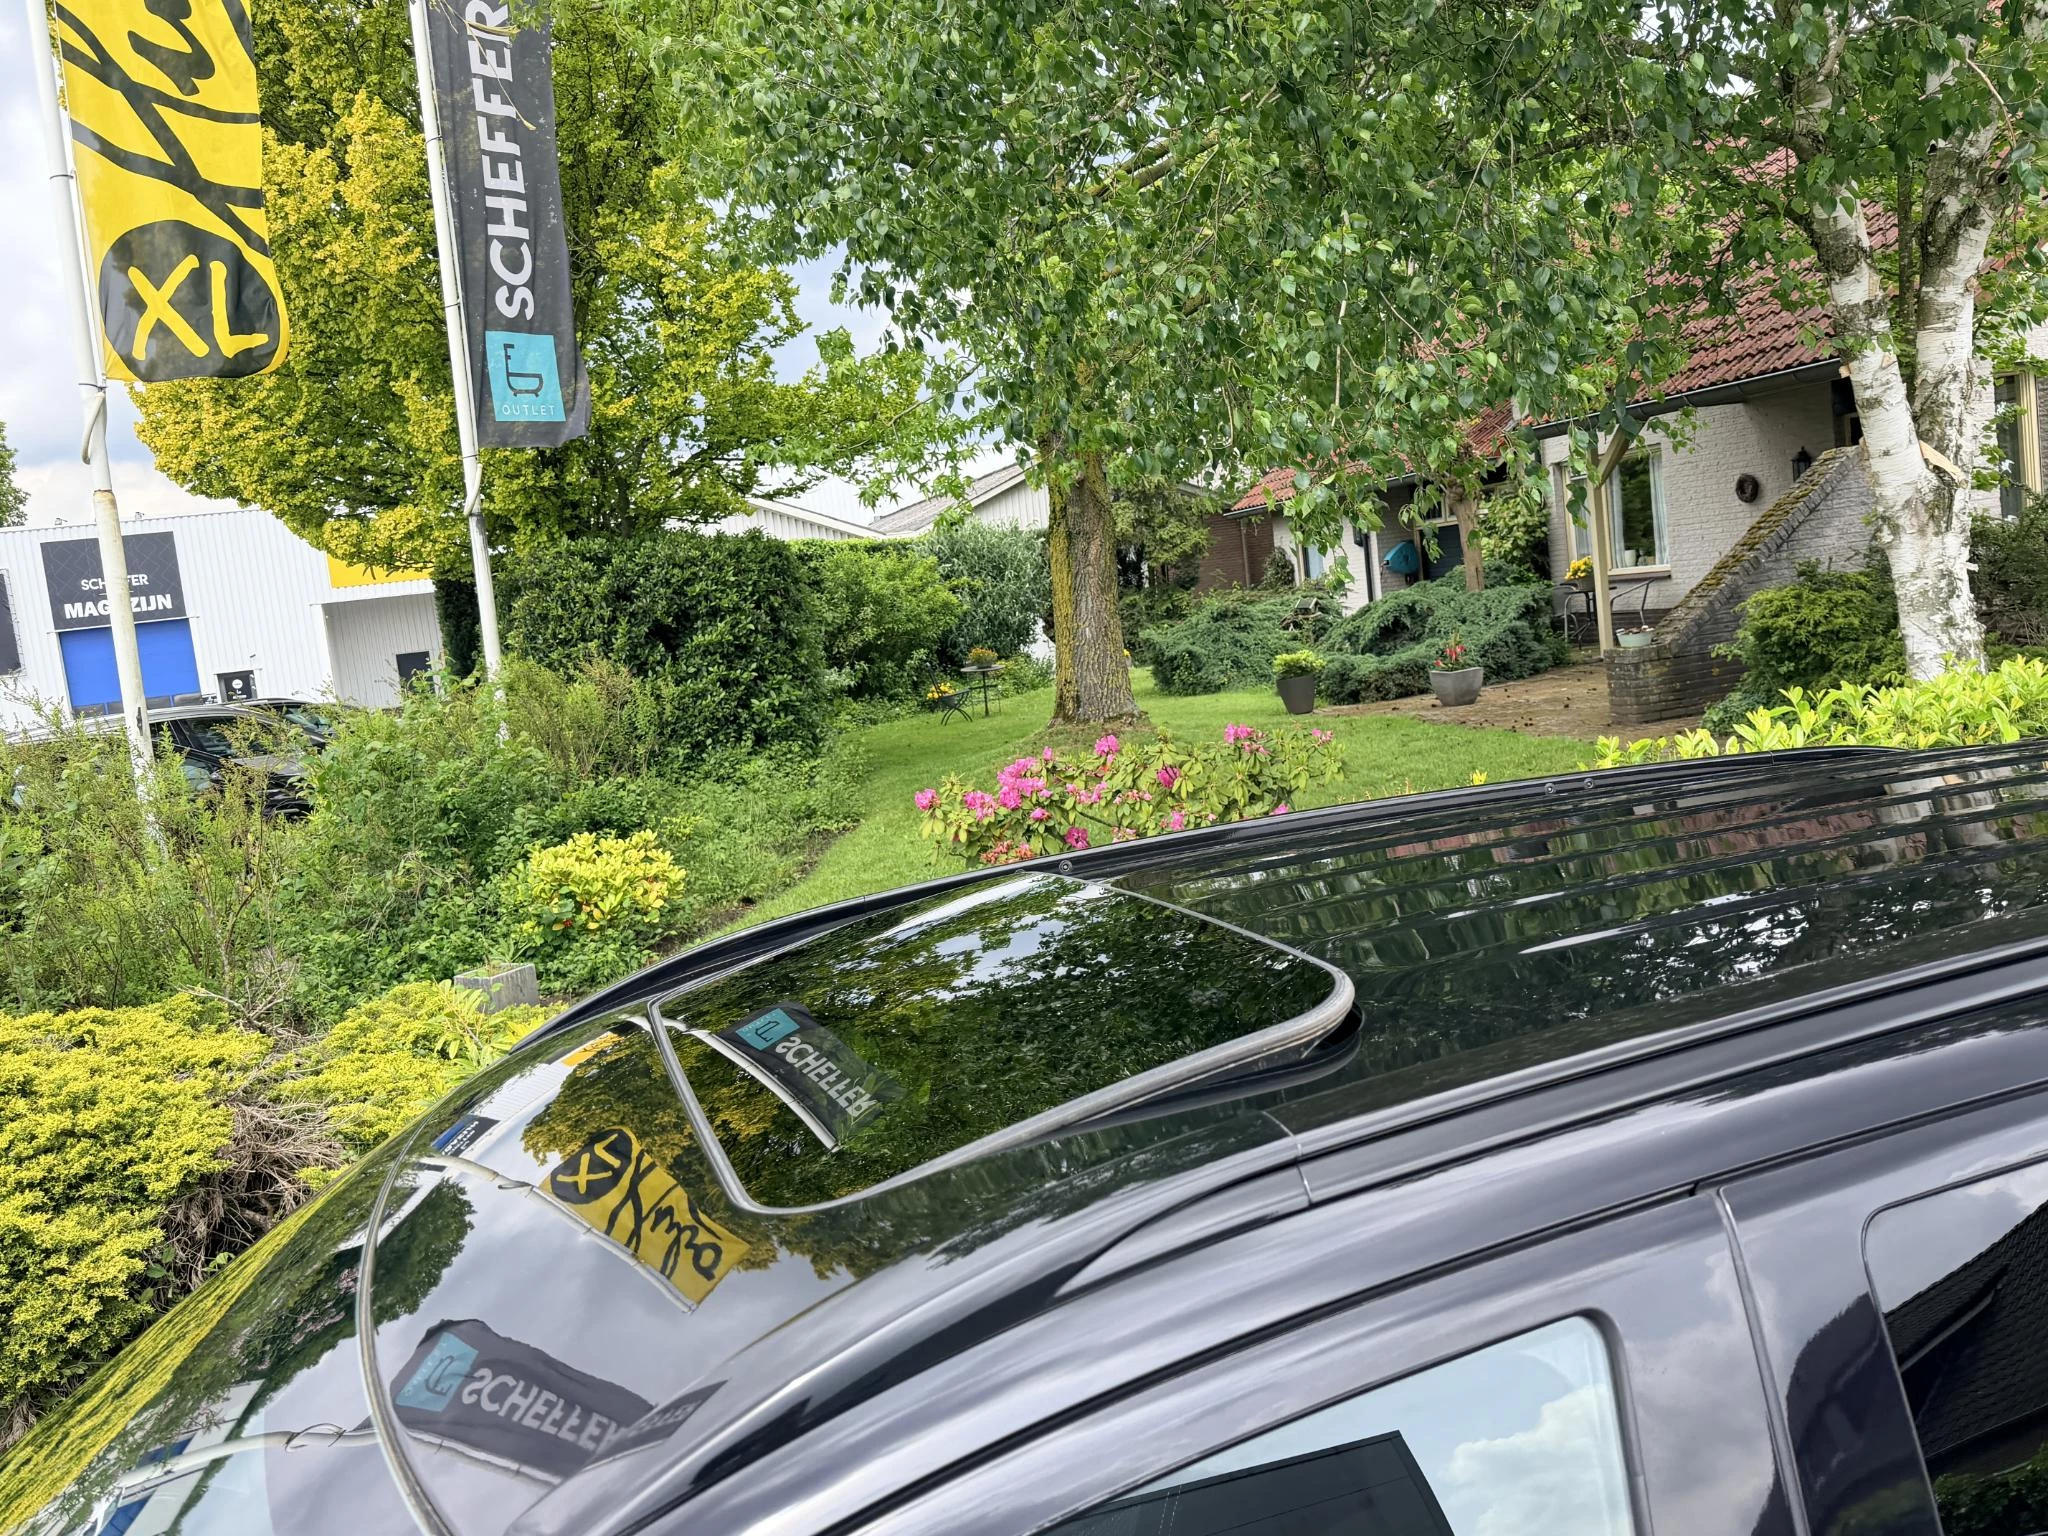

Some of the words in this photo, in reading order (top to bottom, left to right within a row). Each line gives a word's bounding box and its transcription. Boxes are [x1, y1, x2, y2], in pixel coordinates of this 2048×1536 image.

[465, 0, 535, 320] SCHEFFER
[127, 253, 269, 360] XL
[502, 404, 555, 416] OUTLET
[64, 593, 173, 619] MAGZIJN
